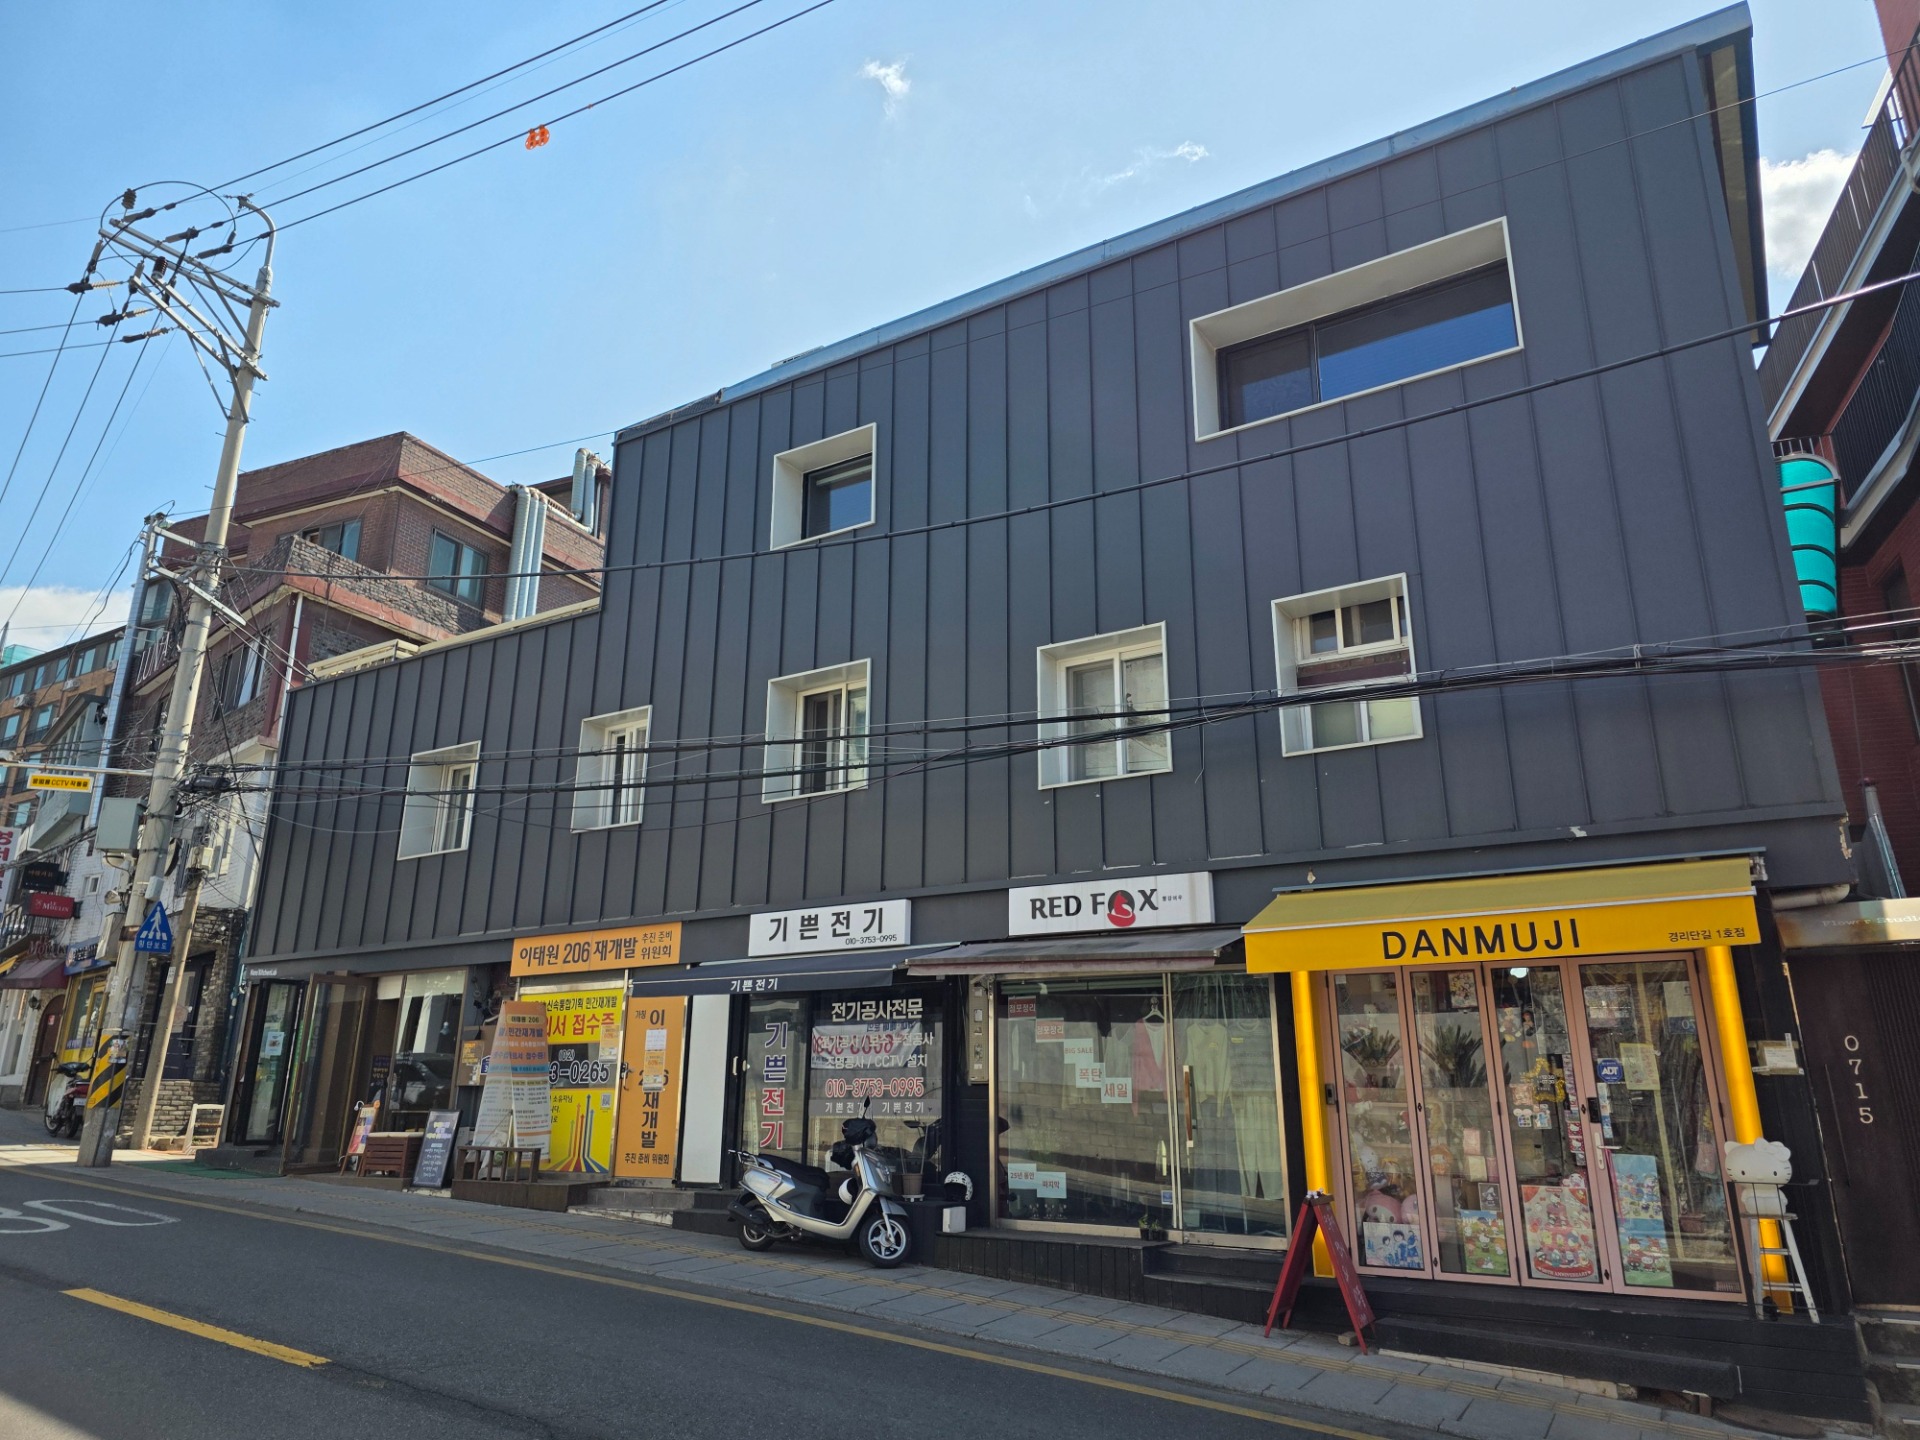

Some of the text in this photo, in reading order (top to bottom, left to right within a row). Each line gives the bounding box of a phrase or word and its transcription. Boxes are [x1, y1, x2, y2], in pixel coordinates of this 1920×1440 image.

[51, 779, 70, 787] CCTV
[1030, 895, 1082, 920] RED
[768, 906, 884, 943] 기쁜전기
[1876, 915, 1920, 925] Studi
[641, 930, 673, 944] 추진 준비
[845, 934, 898, 946] 010-3753-0995
[1381, 917, 1581, 960] DANMUJI
[1668, 927, 1746, 943] 경리단길 1호점
[519, 936, 639, 968] 이태원 206 재개발
[640, 944, 673, 961] 위원회
[730, 977, 779, 993] 기쁜전기
[546, 995, 618, 1012] 신속통합기획 민간재개발
[831, 998, 924, 1023] 전기공사전문
[1077, 1046, 1094, 1054] SALE
[826, 1056, 864, 1069] 조명공사
[874, 1055, 904, 1068] CCTV
[907, 1053, 928, 1068] 설치
[1079, 1067, 1103, 1083] 폭탄
[1601, 1066, 1619, 1075] ADT
[825, 1077, 924, 1098] 010-3753-0995
[1843, 1035, 1875, 1124] 0715
[1103, 1083, 1128, 1098] 세일
[552, 1094, 573, 1104] 소유자님
[641, 1092, 660, 1148] 재개발
[625, 1152, 670, 1166] 추진 준비 위원회
